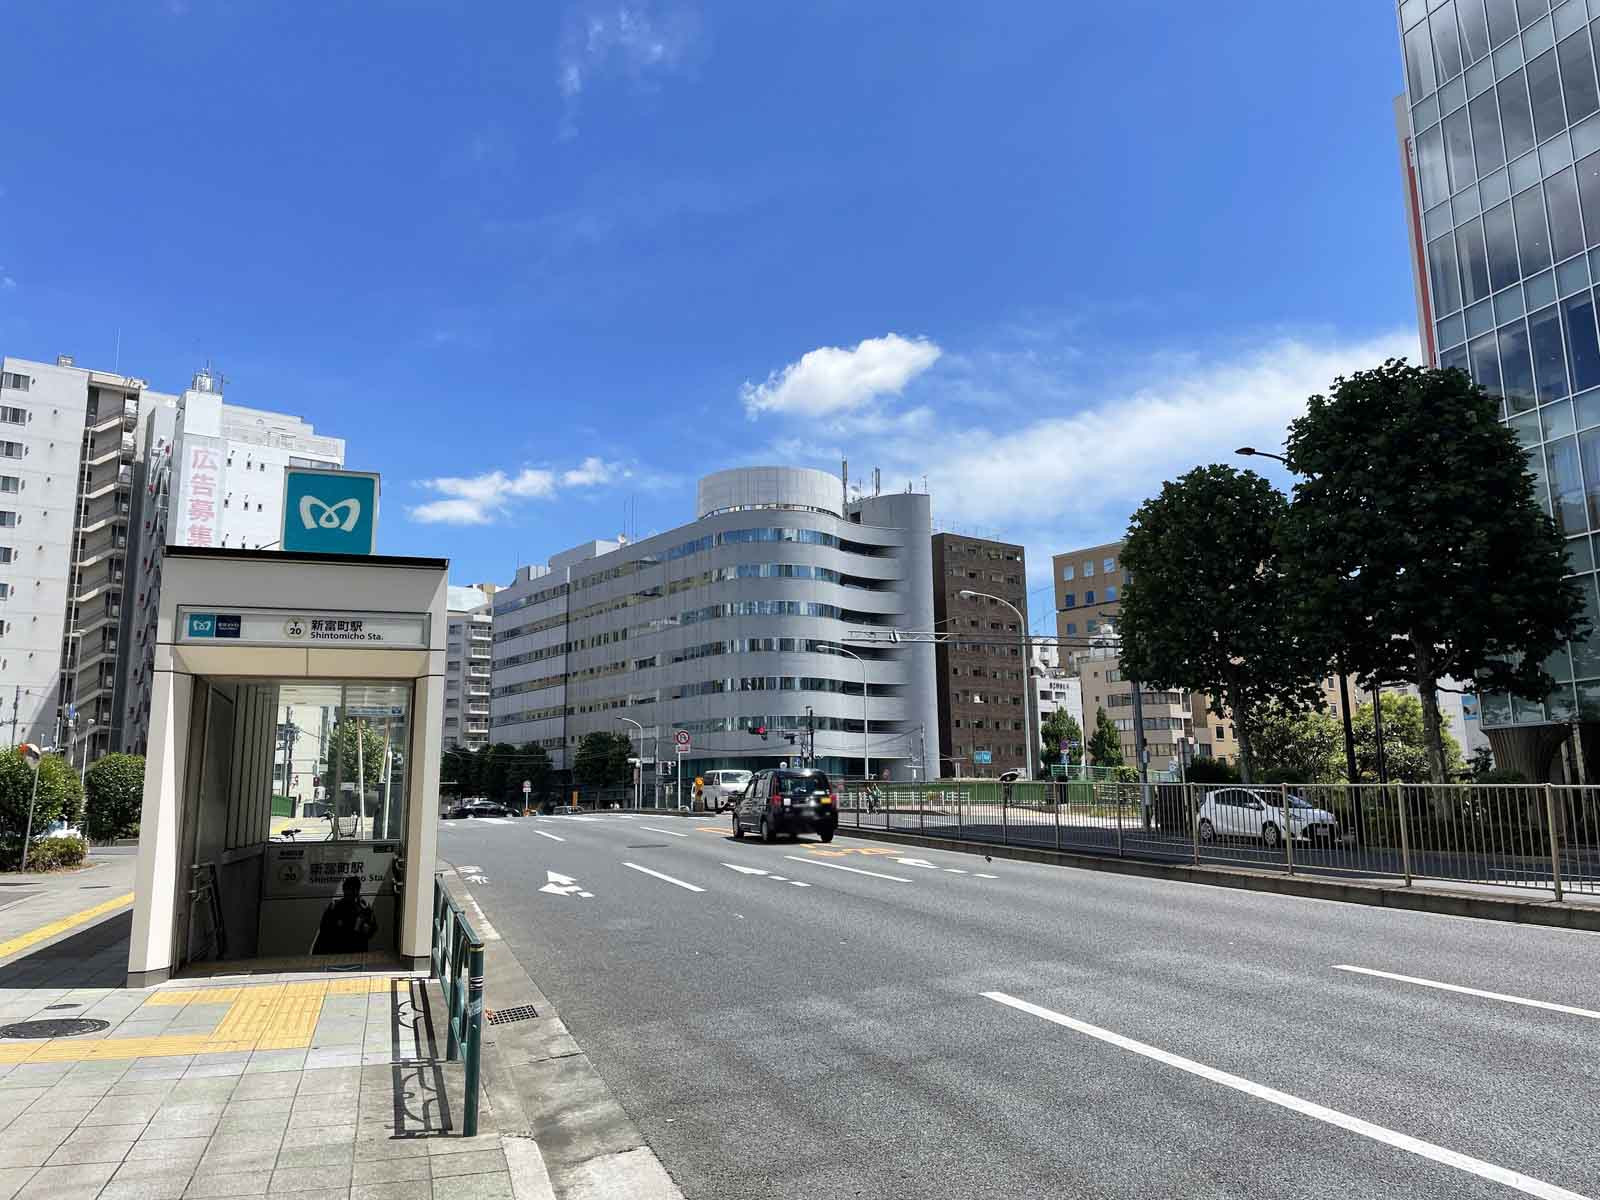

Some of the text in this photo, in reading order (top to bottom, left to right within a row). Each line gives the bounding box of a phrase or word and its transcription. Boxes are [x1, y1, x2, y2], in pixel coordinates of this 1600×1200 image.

[187, 448, 218, 547] 広告募集
[290, 627, 302, 635] 20
[311, 619, 363, 632] 新富町駅
[311, 631, 384, 640] Shintomicho Sta.
